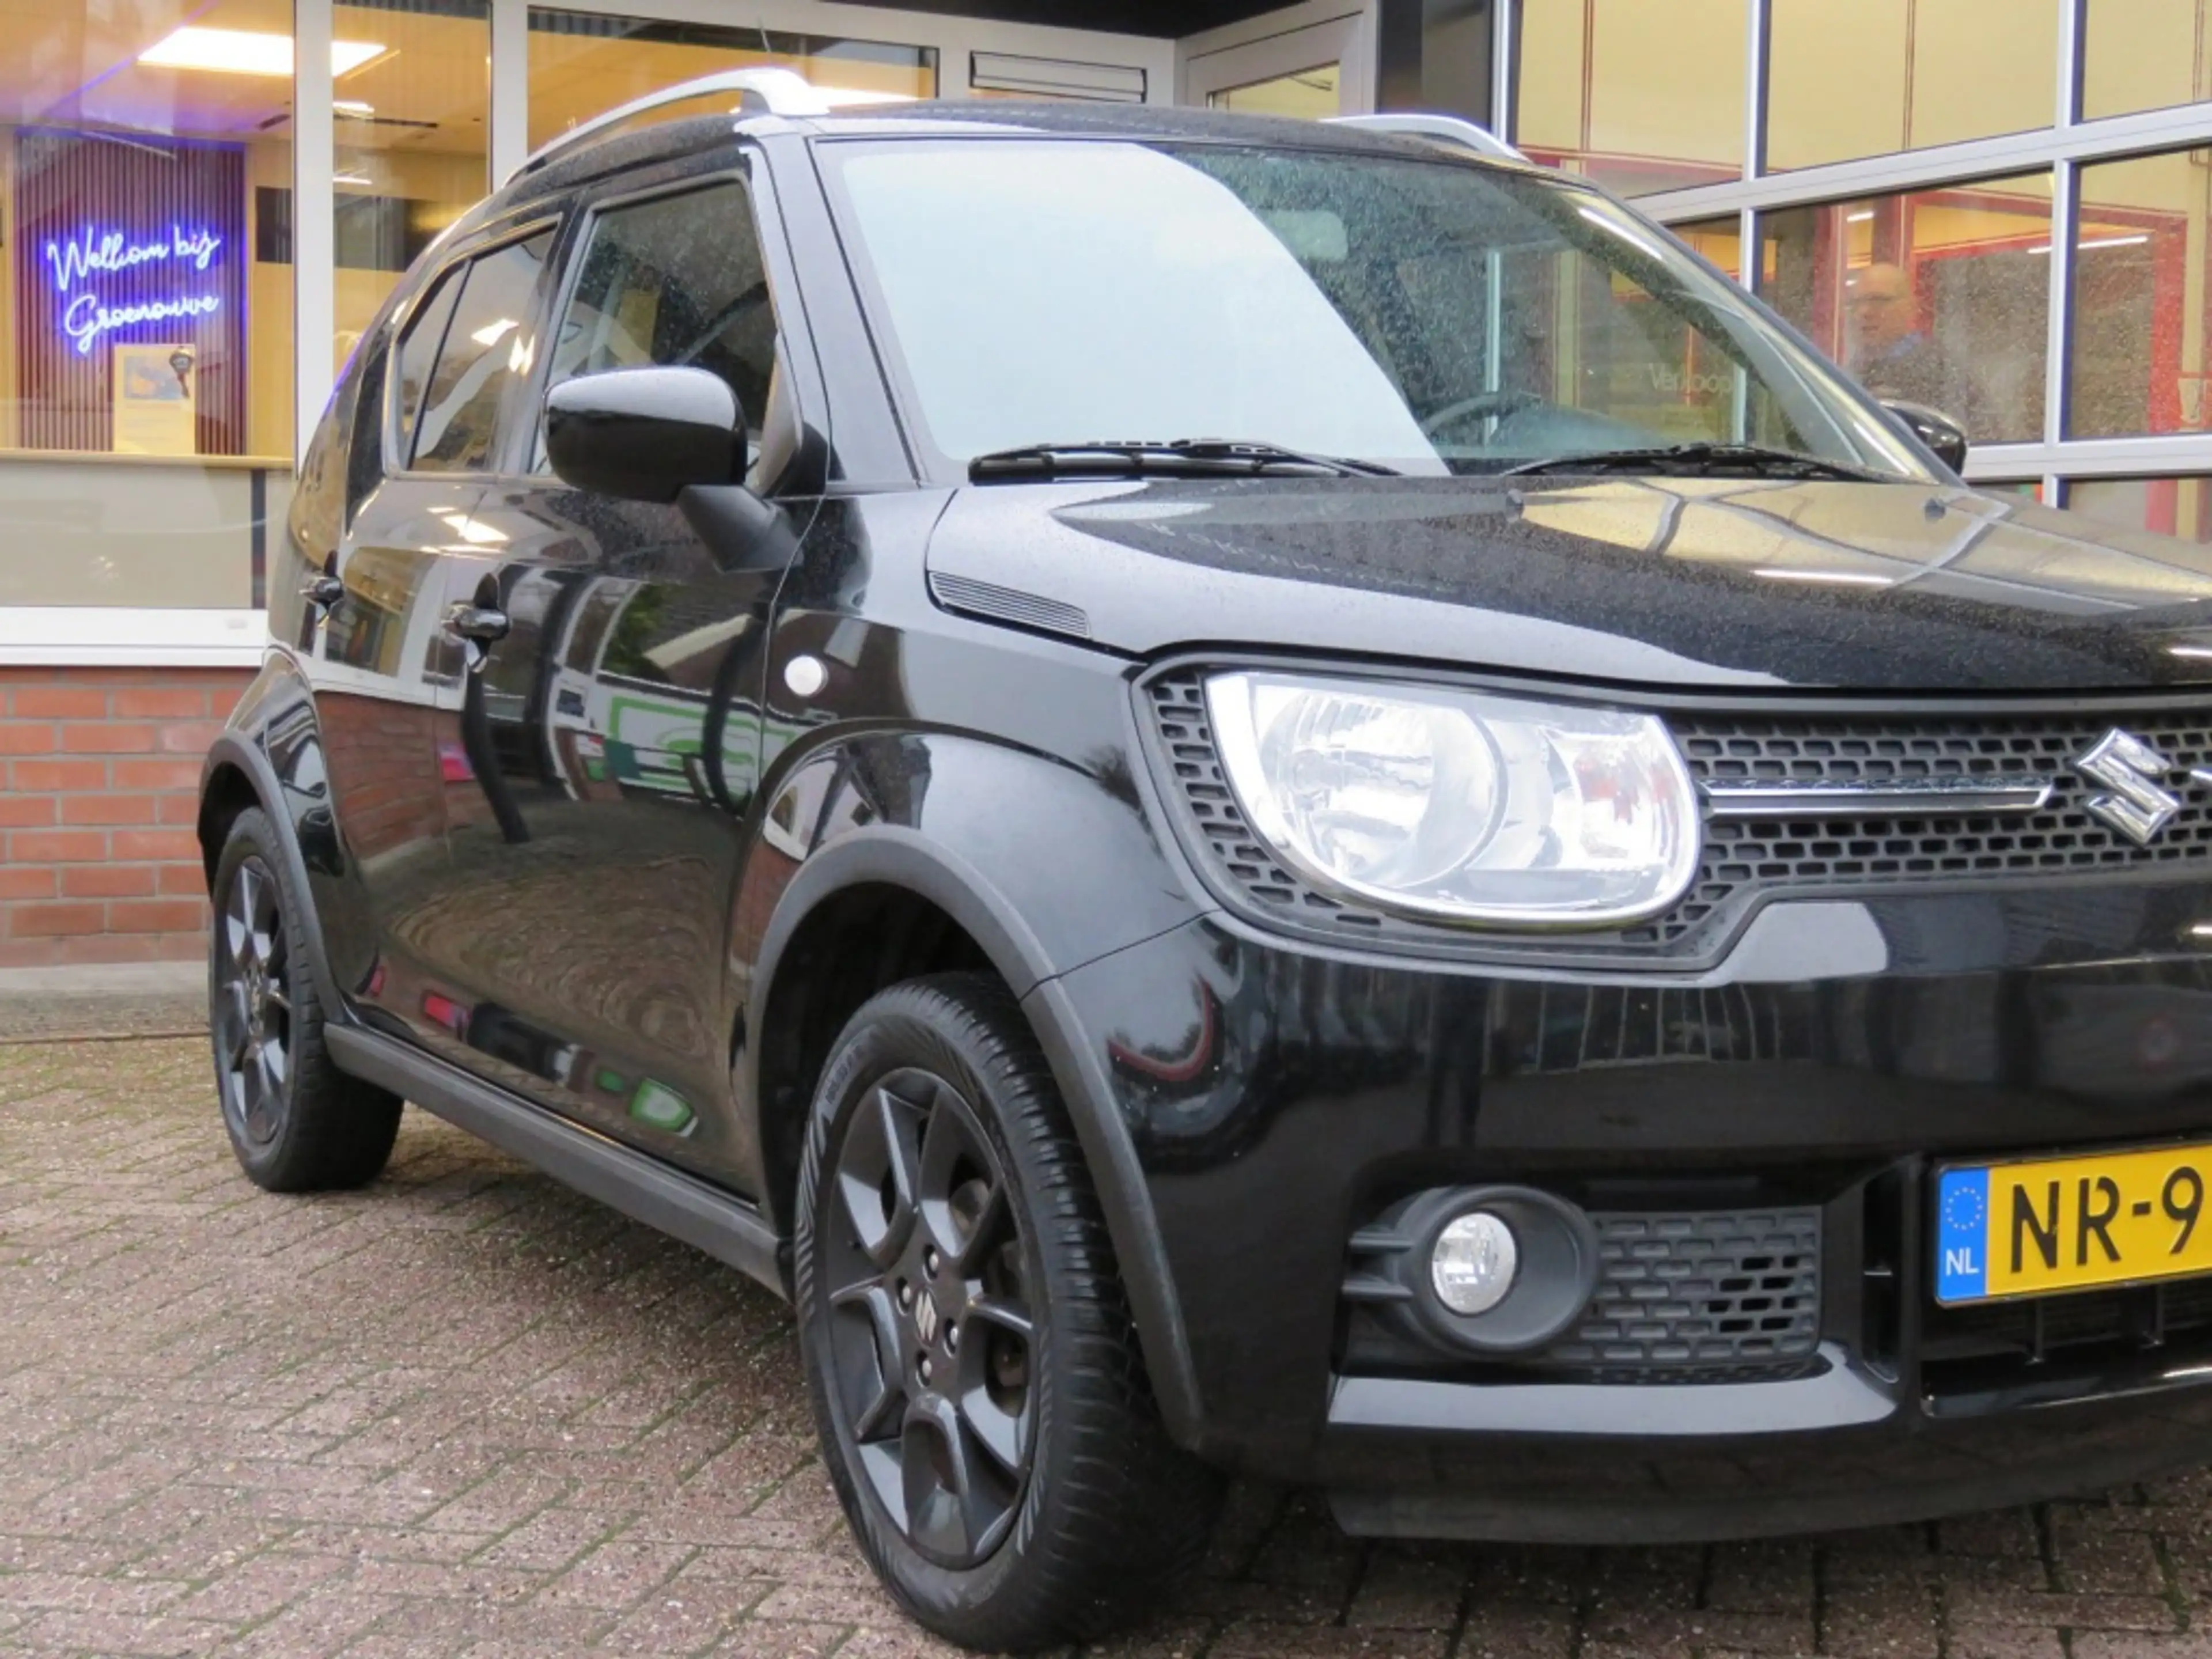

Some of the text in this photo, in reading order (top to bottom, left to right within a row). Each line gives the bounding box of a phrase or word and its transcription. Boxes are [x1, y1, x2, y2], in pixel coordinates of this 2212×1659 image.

[47, 225, 221, 290] Welkom bij
[2010, 1166, 2204, 1274] NR-9
[1946, 1247, 1979, 1277] NL
